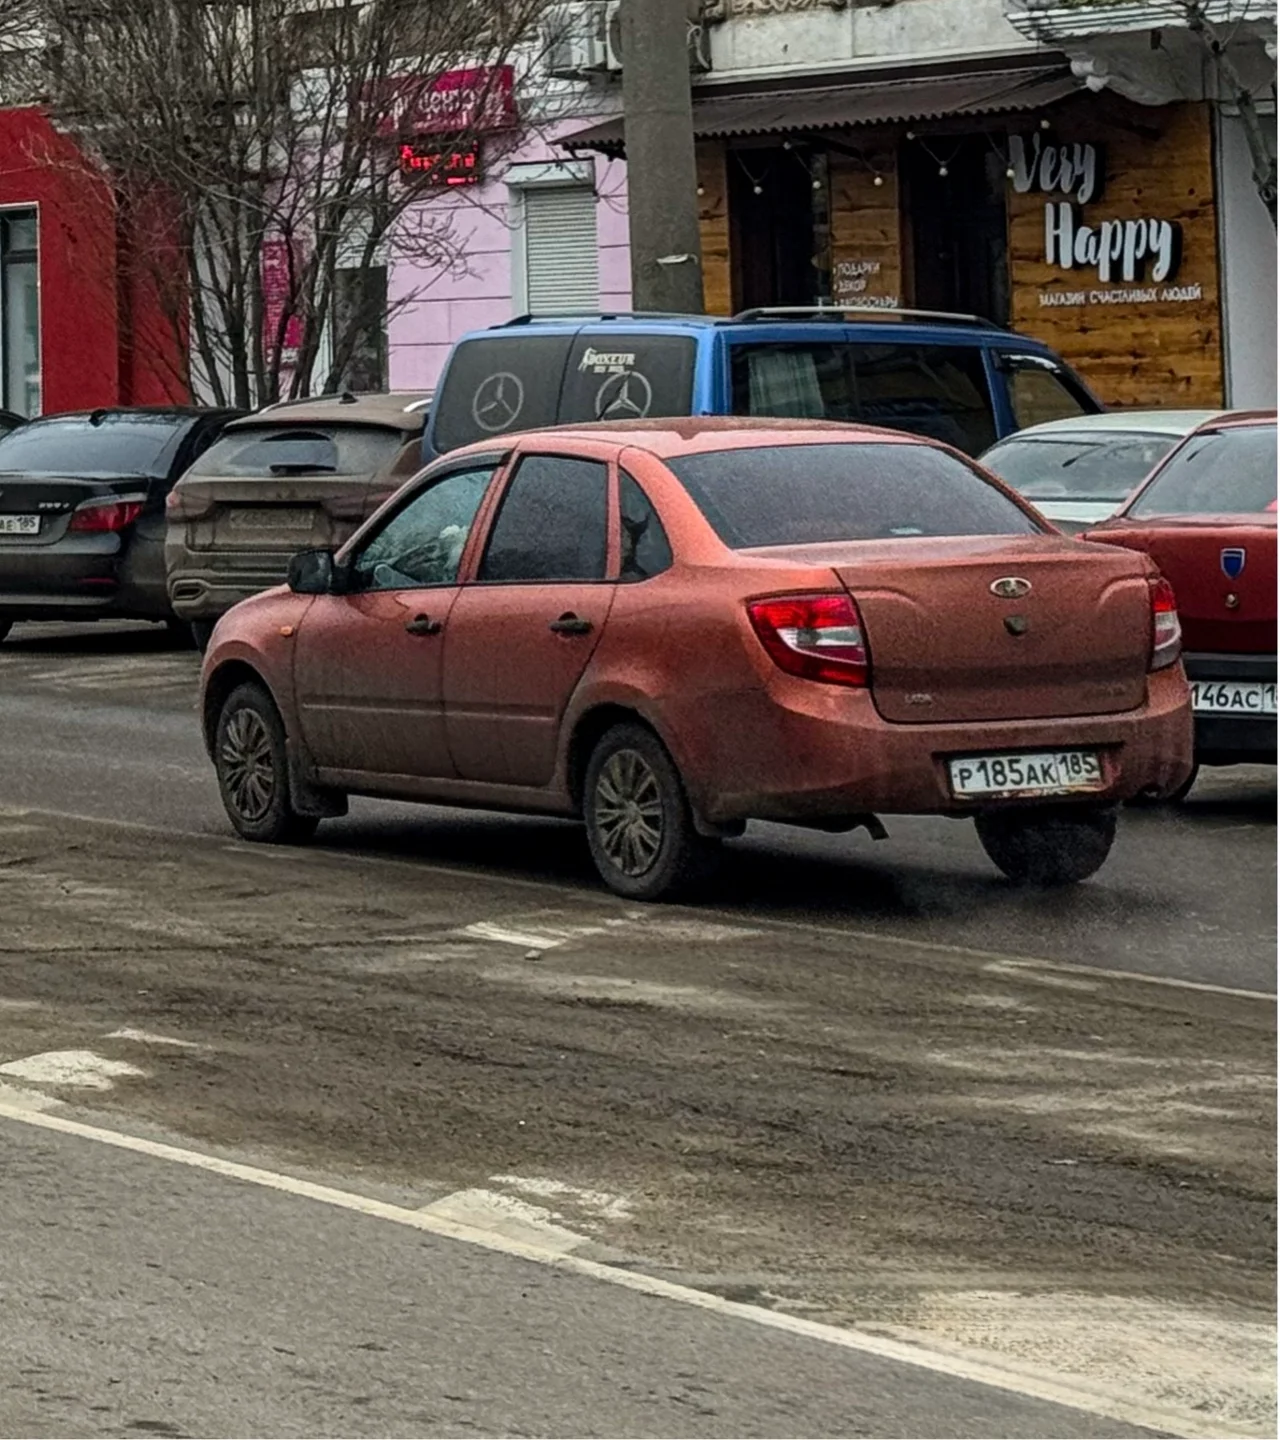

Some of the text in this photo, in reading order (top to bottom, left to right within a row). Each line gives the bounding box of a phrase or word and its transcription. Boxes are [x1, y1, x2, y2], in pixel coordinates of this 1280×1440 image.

[1008, 132, 1096, 205] Very
[1045, 202, 1172, 283] Happy
[1039, 291, 1086, 307] МАГАЗИН
[1161, 283, 1201, 301] ЛЮДЕЙ
[1191, 683, 1260, 709] 146АС
[958, 753, 1097, 789] Р185АК 185
